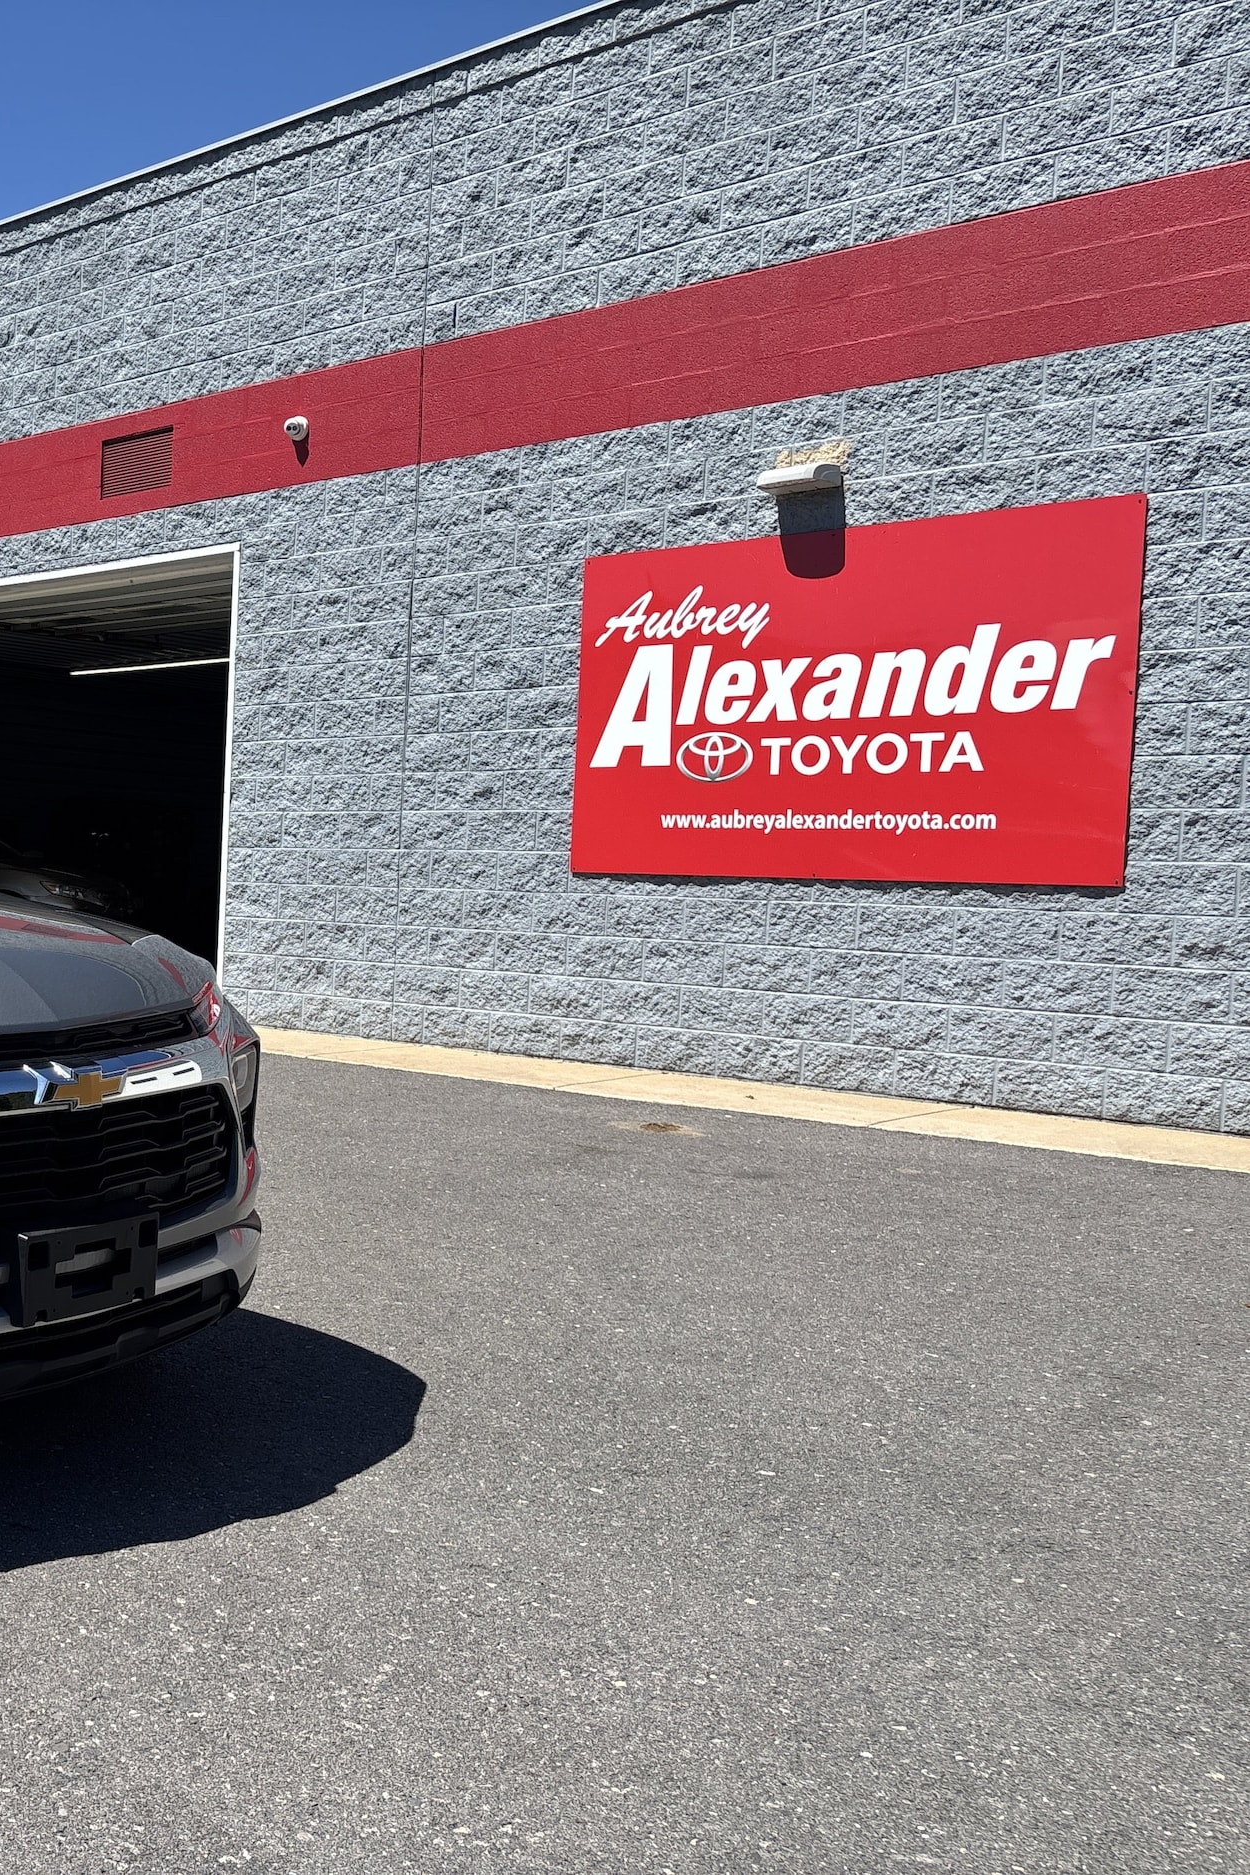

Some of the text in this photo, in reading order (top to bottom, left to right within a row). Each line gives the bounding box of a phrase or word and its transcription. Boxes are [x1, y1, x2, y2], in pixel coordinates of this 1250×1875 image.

[595, 585, 770, 649] Aubrey
[590, 623, 1117, 768] Alexander
[760, 731, 985, 776] TOYOTA
[660, 808, 997, 835] www.aubreyalexandertoyota.com
